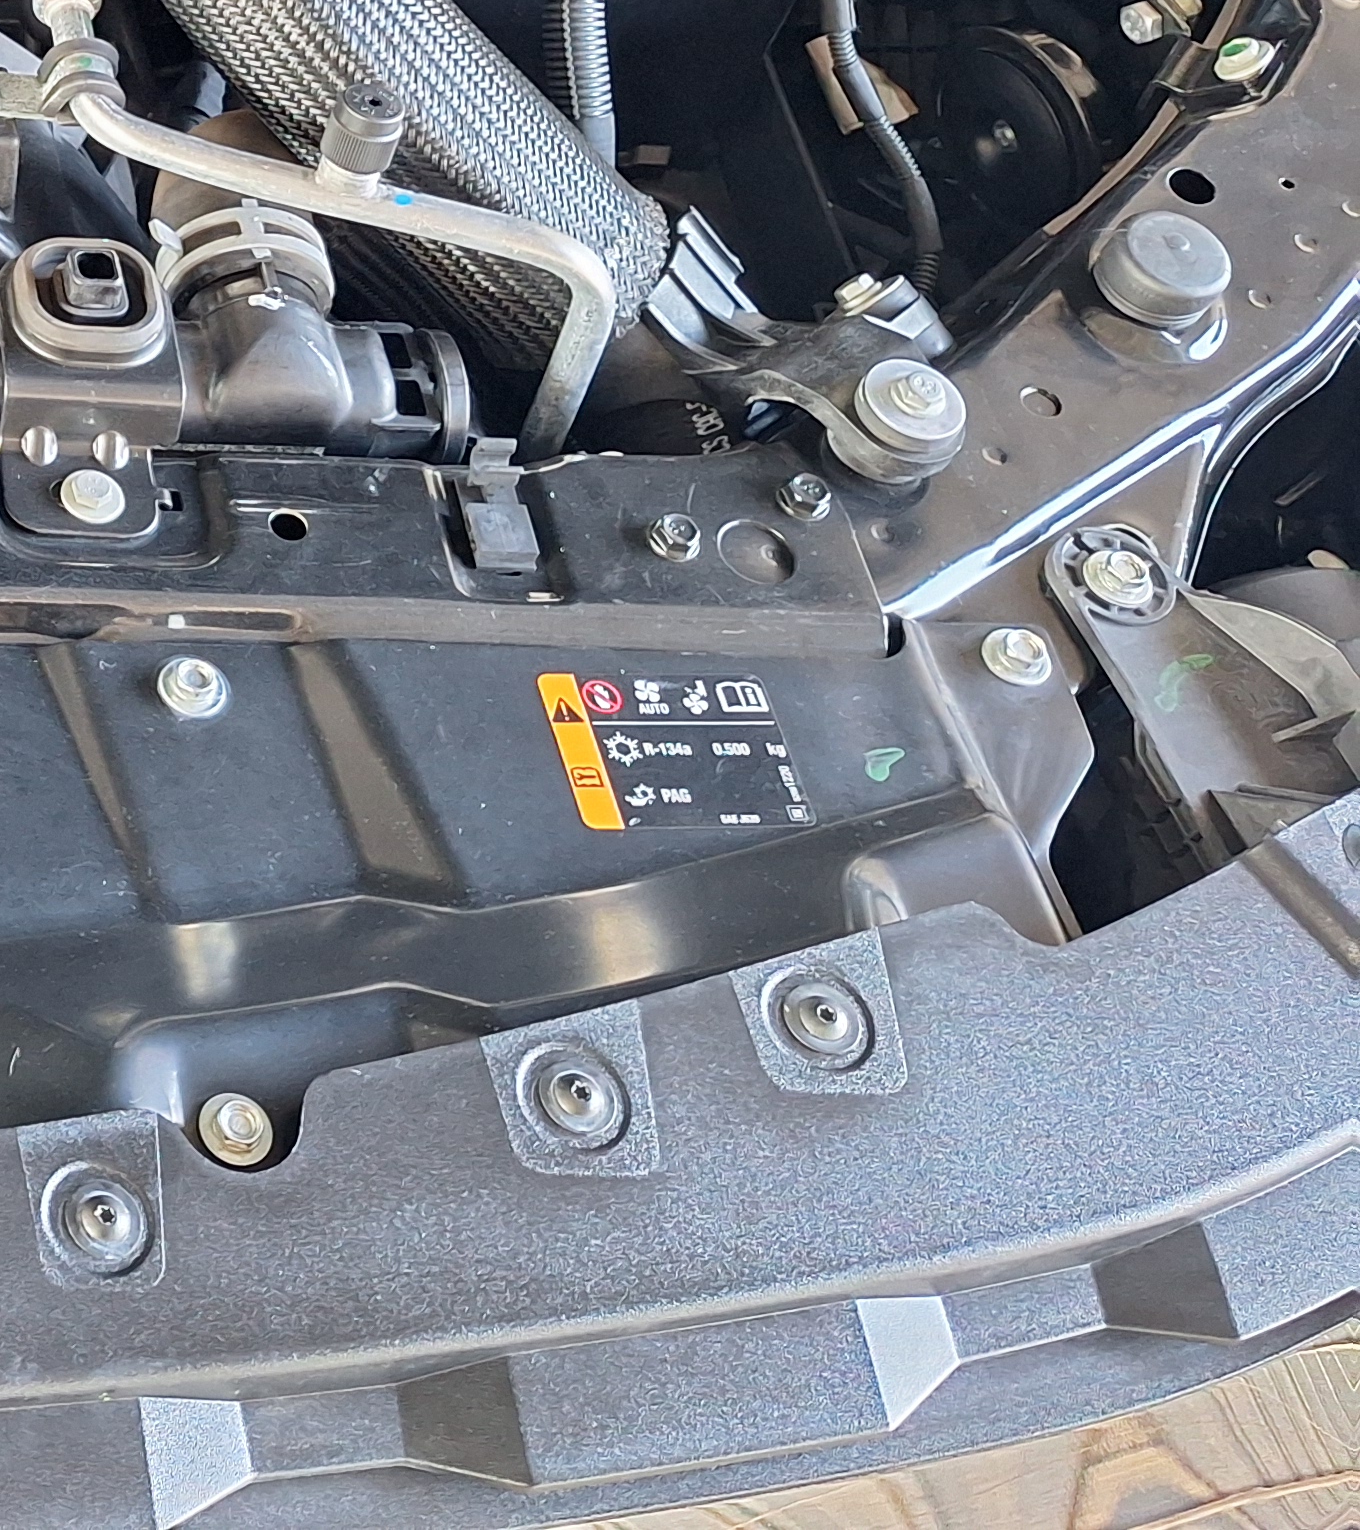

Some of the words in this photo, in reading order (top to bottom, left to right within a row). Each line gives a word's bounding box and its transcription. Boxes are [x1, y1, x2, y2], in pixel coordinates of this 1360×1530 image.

[639, 703, 670, 715] AUTO
[642, 742, 693, 757] R-134a
[765, 742, 787, 758] kg
[660, 788, 692, 803] PAG
